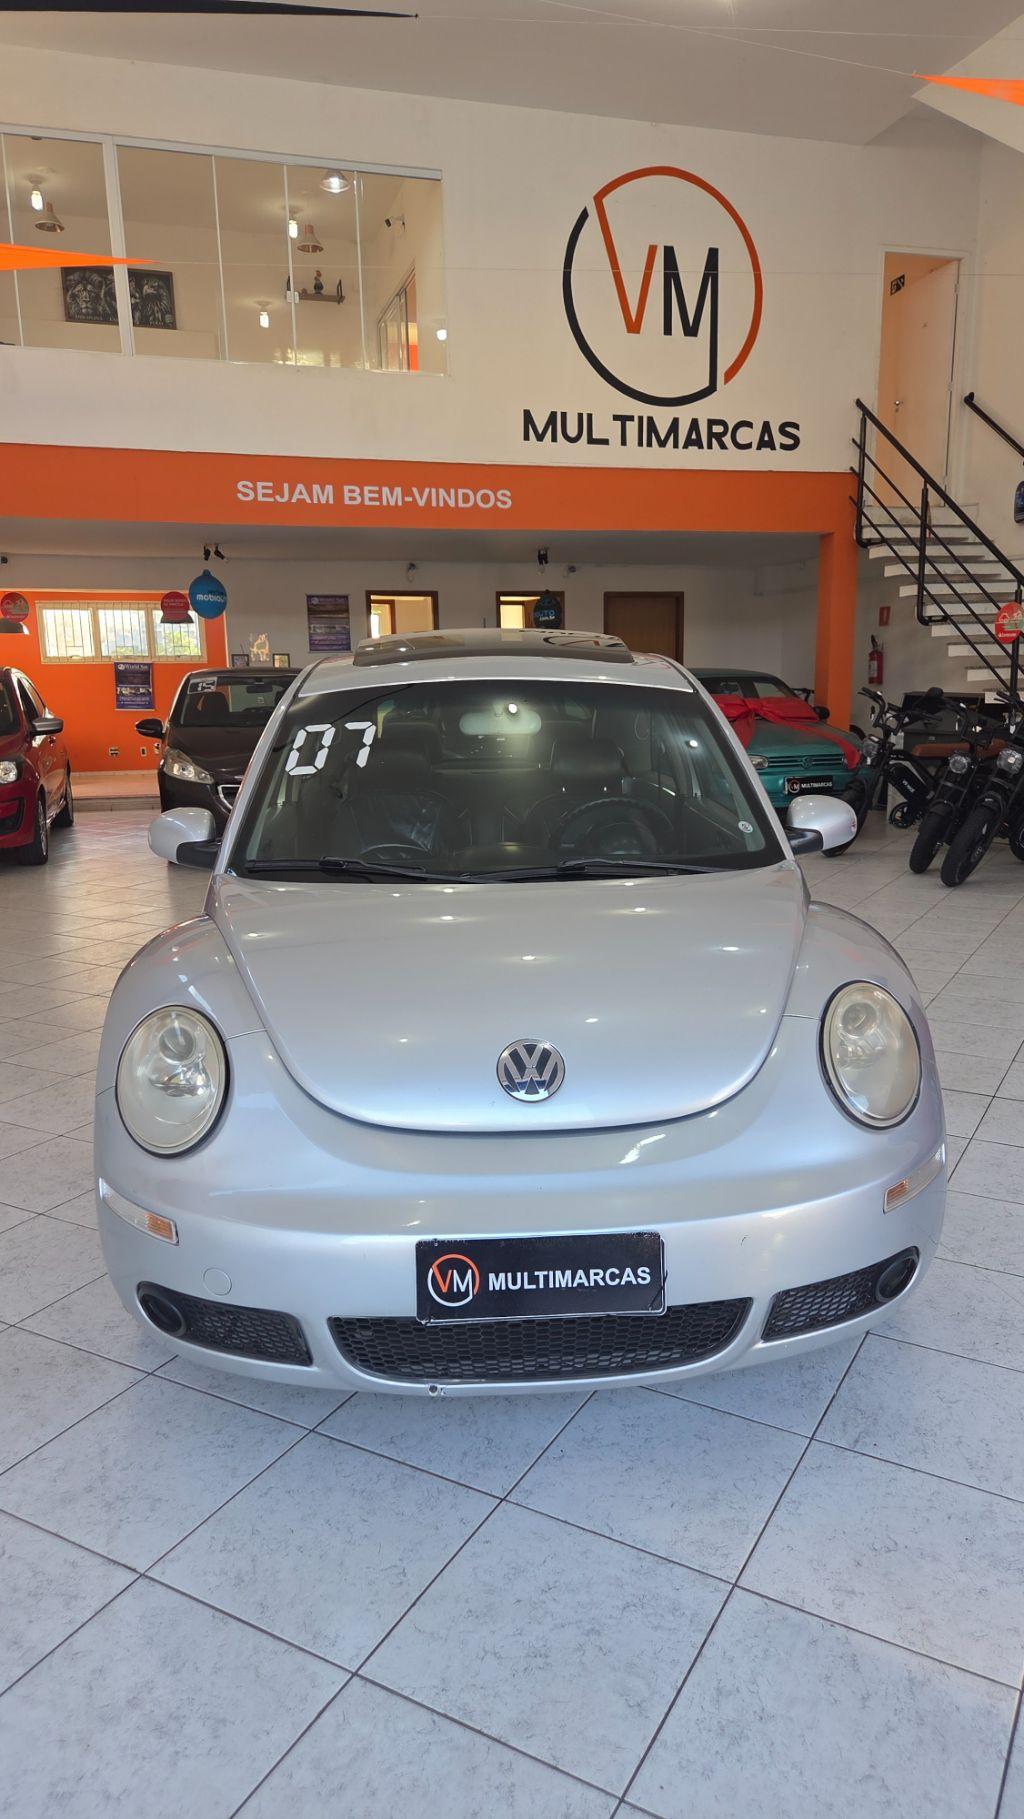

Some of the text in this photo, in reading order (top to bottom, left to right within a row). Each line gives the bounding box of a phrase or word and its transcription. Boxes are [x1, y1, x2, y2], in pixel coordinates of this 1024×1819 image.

[523, 408, 801, 451] MULTIMARCAS
[236, 480, 512, 509] SEJAM BEM-VINDOS
[285, 721, 377, 776] 07
[488, 1266, 651, 1292] MULTIMARCAS
